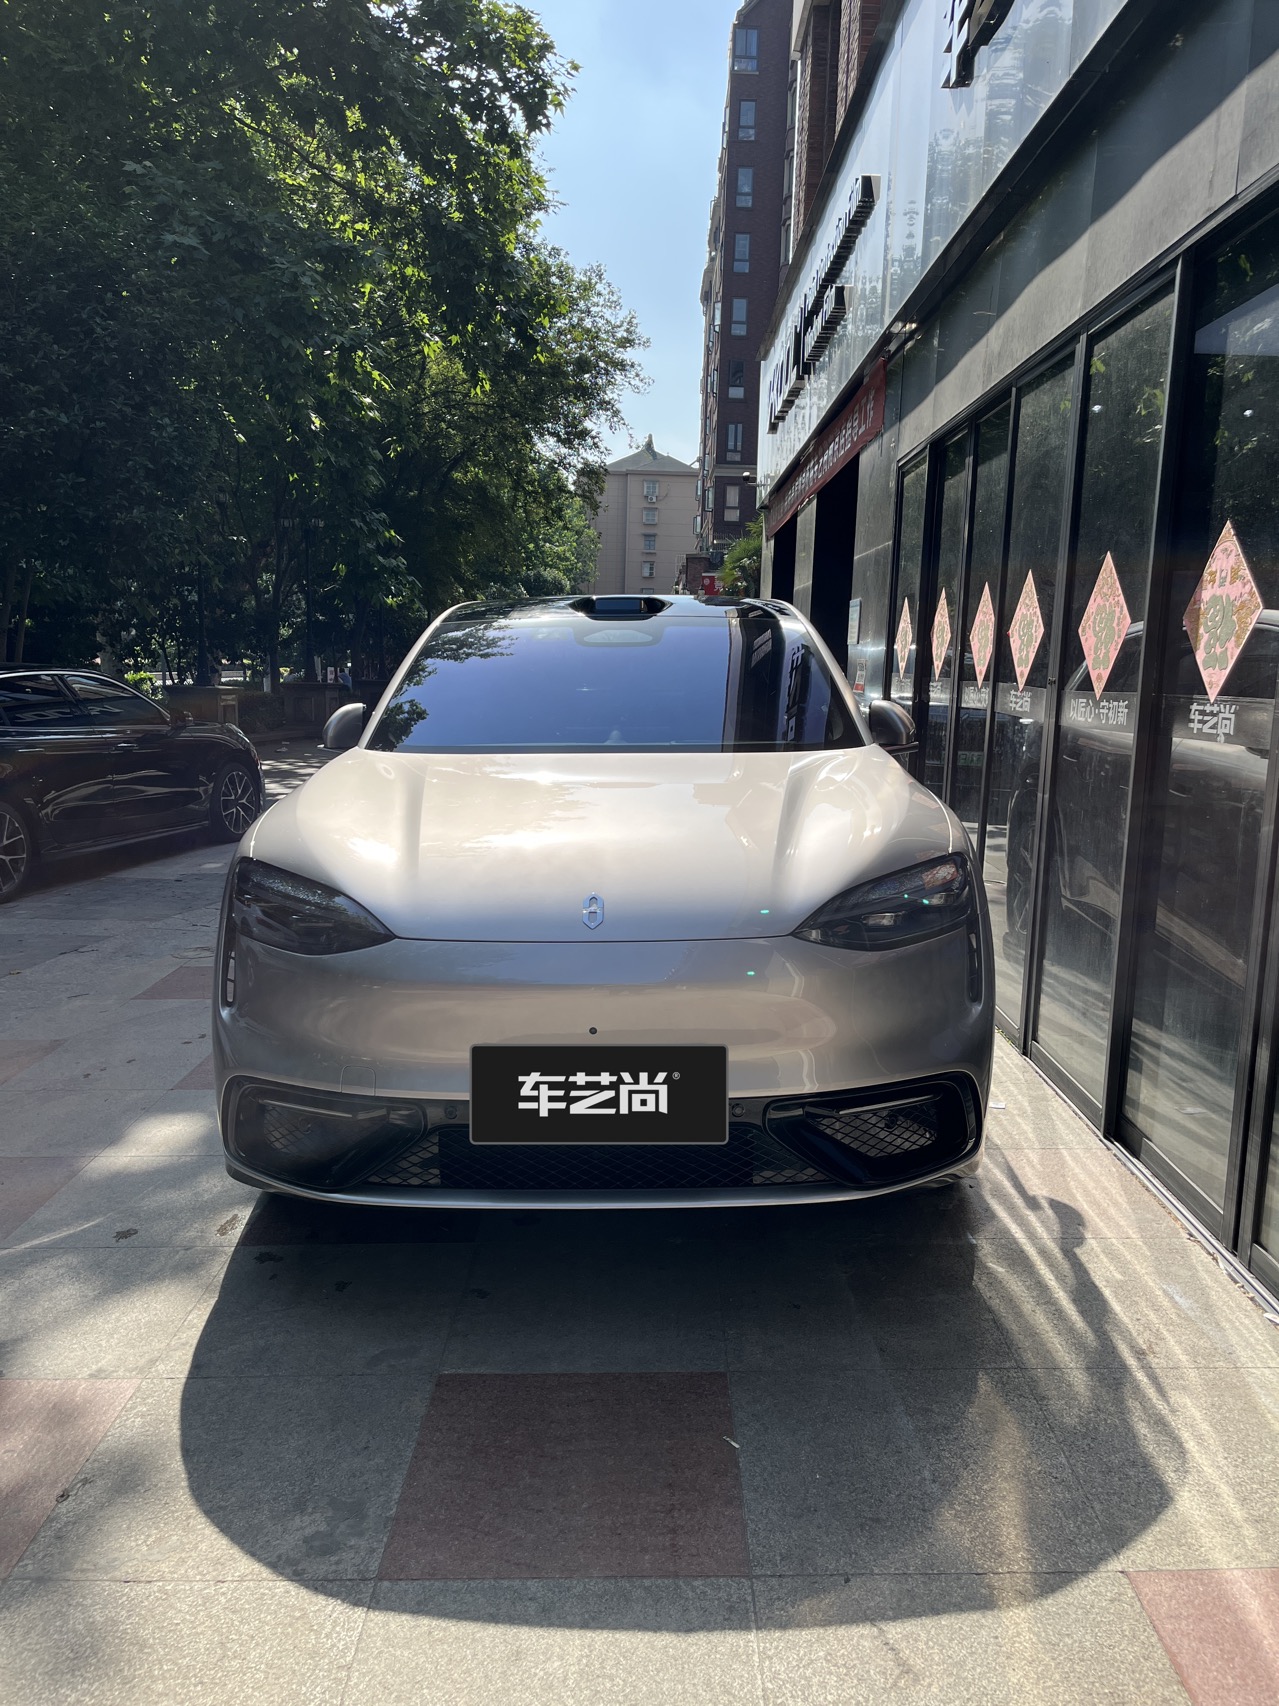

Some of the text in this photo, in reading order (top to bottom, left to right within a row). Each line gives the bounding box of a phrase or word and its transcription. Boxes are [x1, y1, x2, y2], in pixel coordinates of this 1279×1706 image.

[1070, 698, 1129, 726] 以匠心·守初新
[1188, 703, 1236, 735] 车艺尚
[518, 1072, 668, 1117] 车艺尚
